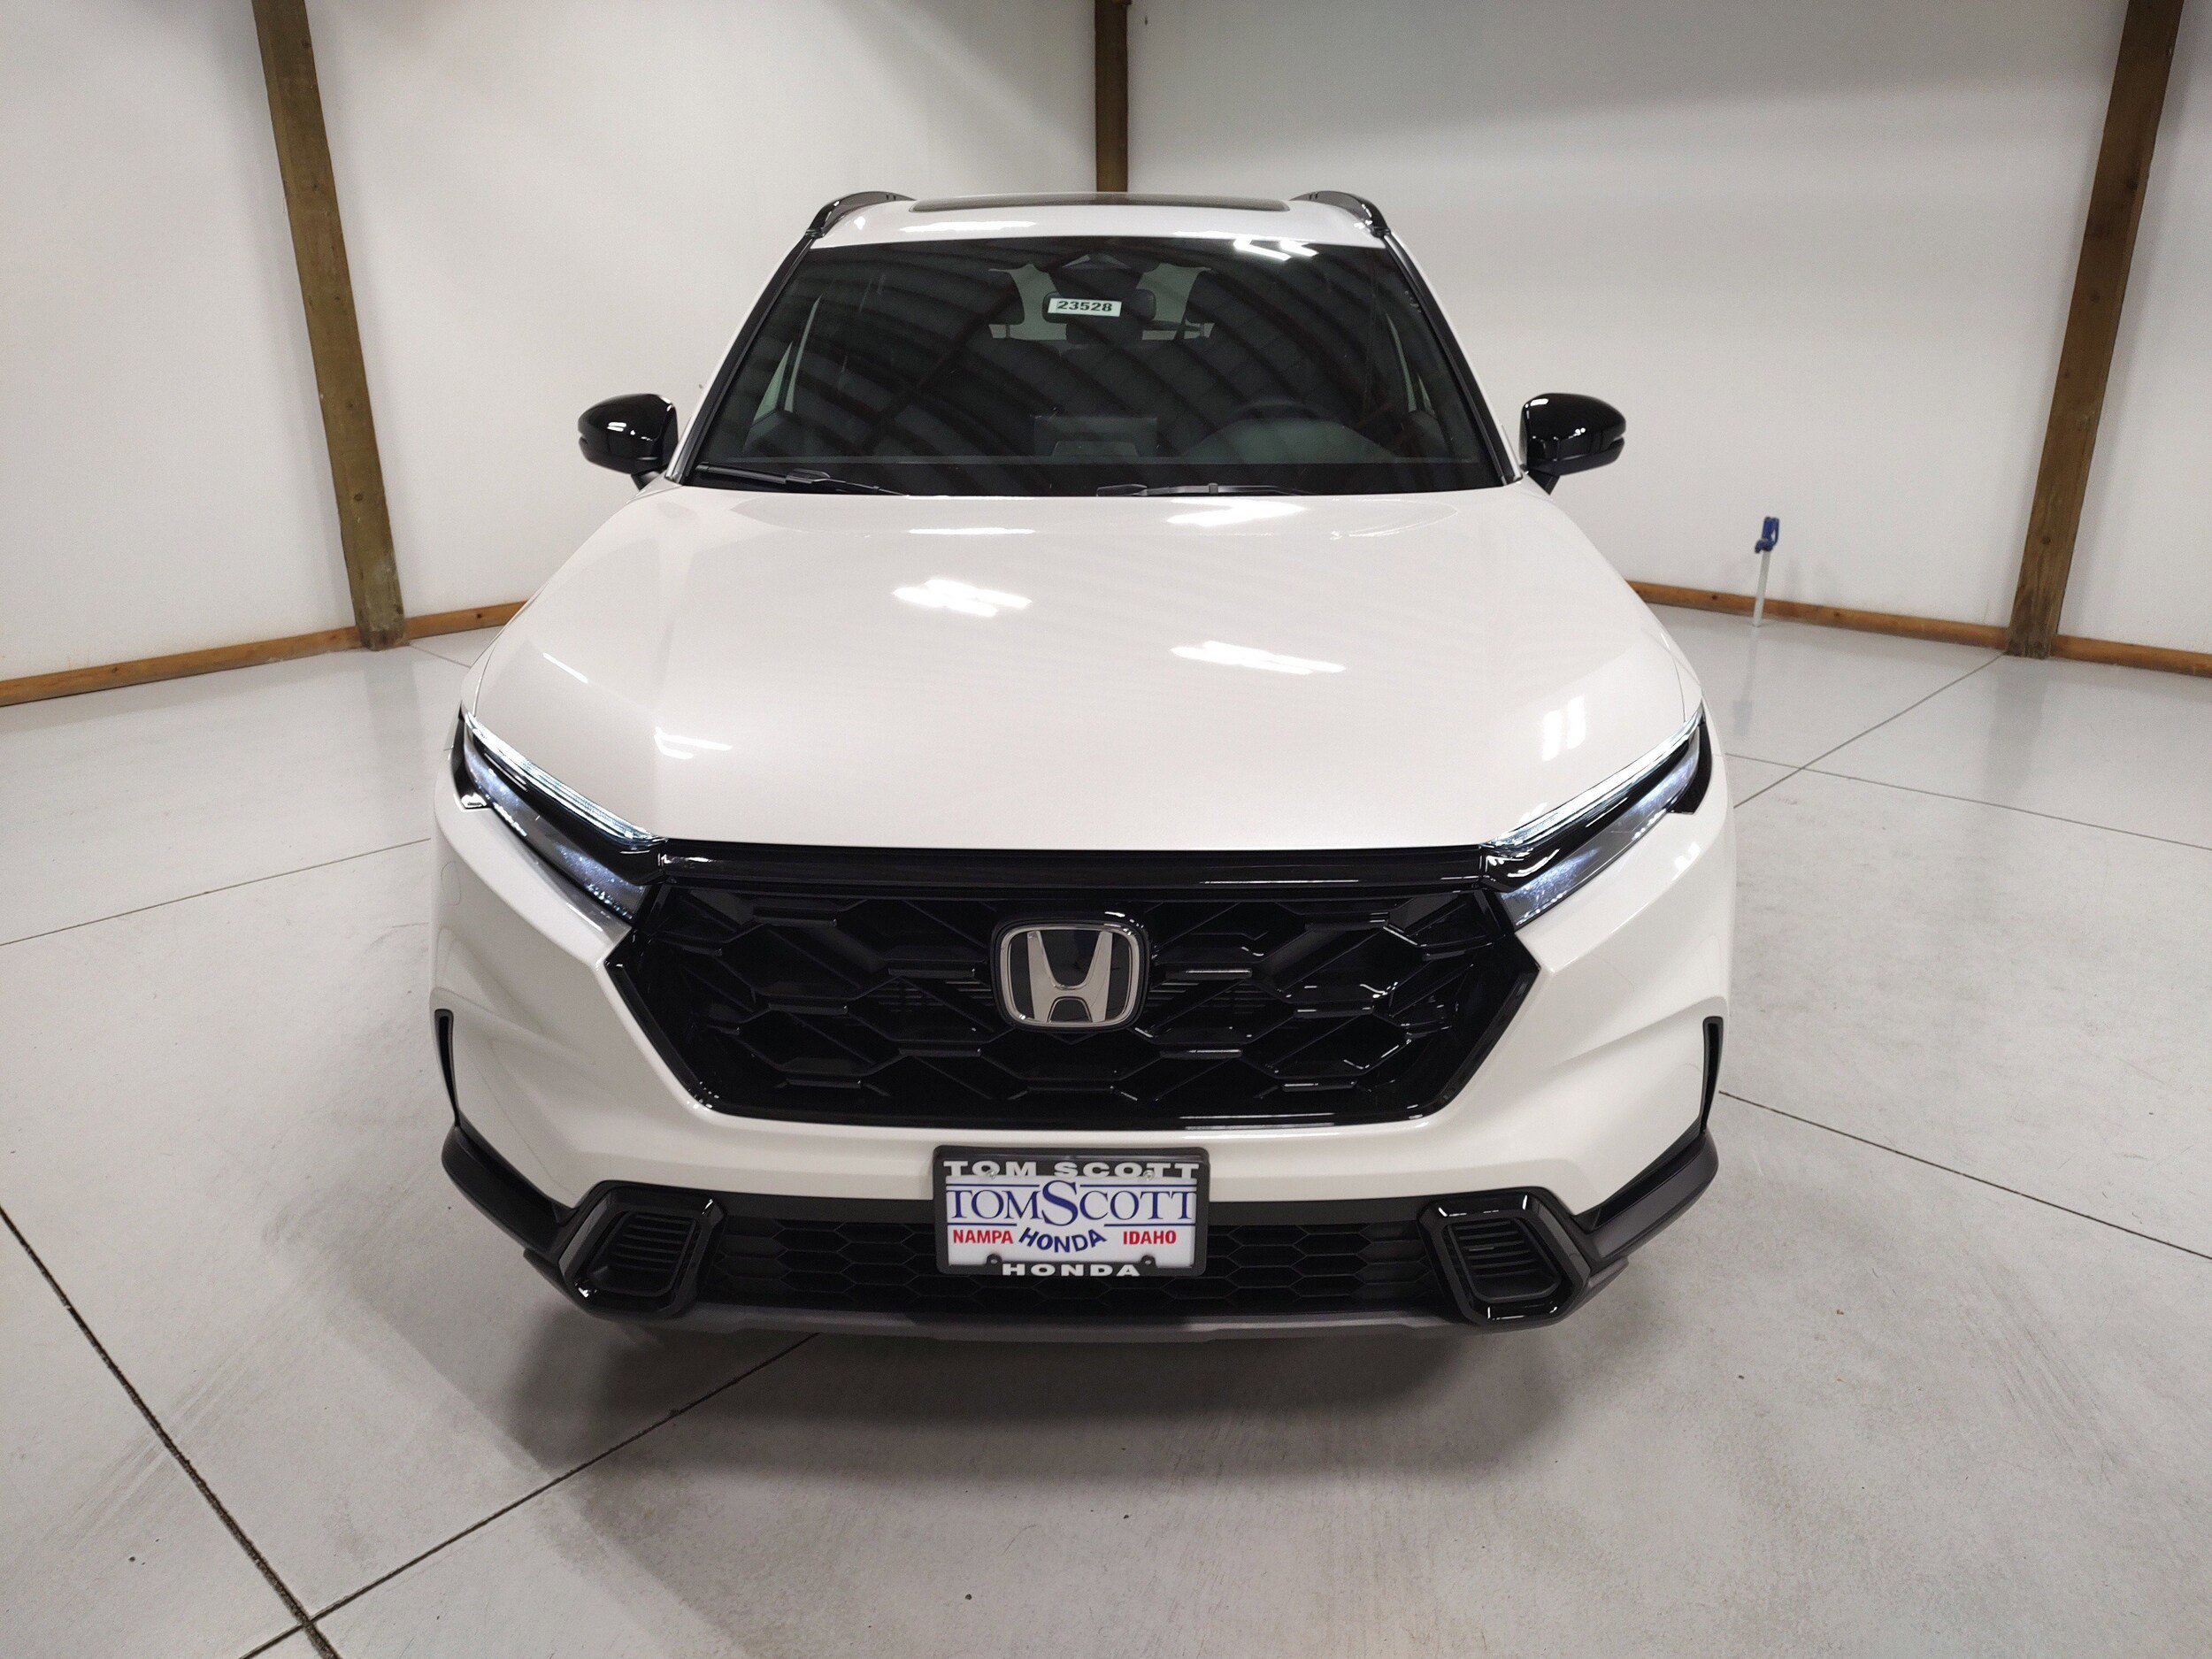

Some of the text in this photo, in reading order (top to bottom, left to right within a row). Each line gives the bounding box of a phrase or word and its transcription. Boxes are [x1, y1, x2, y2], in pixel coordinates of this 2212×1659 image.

[1056, 301, 1112, 312] 23528
[943, 1160, 1200, 1179] TOM SCOTT
[952, 1229, 1014, 1244] NAMPA
[1018, 1226, 1107, 1253] HONDA
[1123, 1230, 1177, 1245] IDAHO
[1002, 1263, 1141, 1277] HONDA
